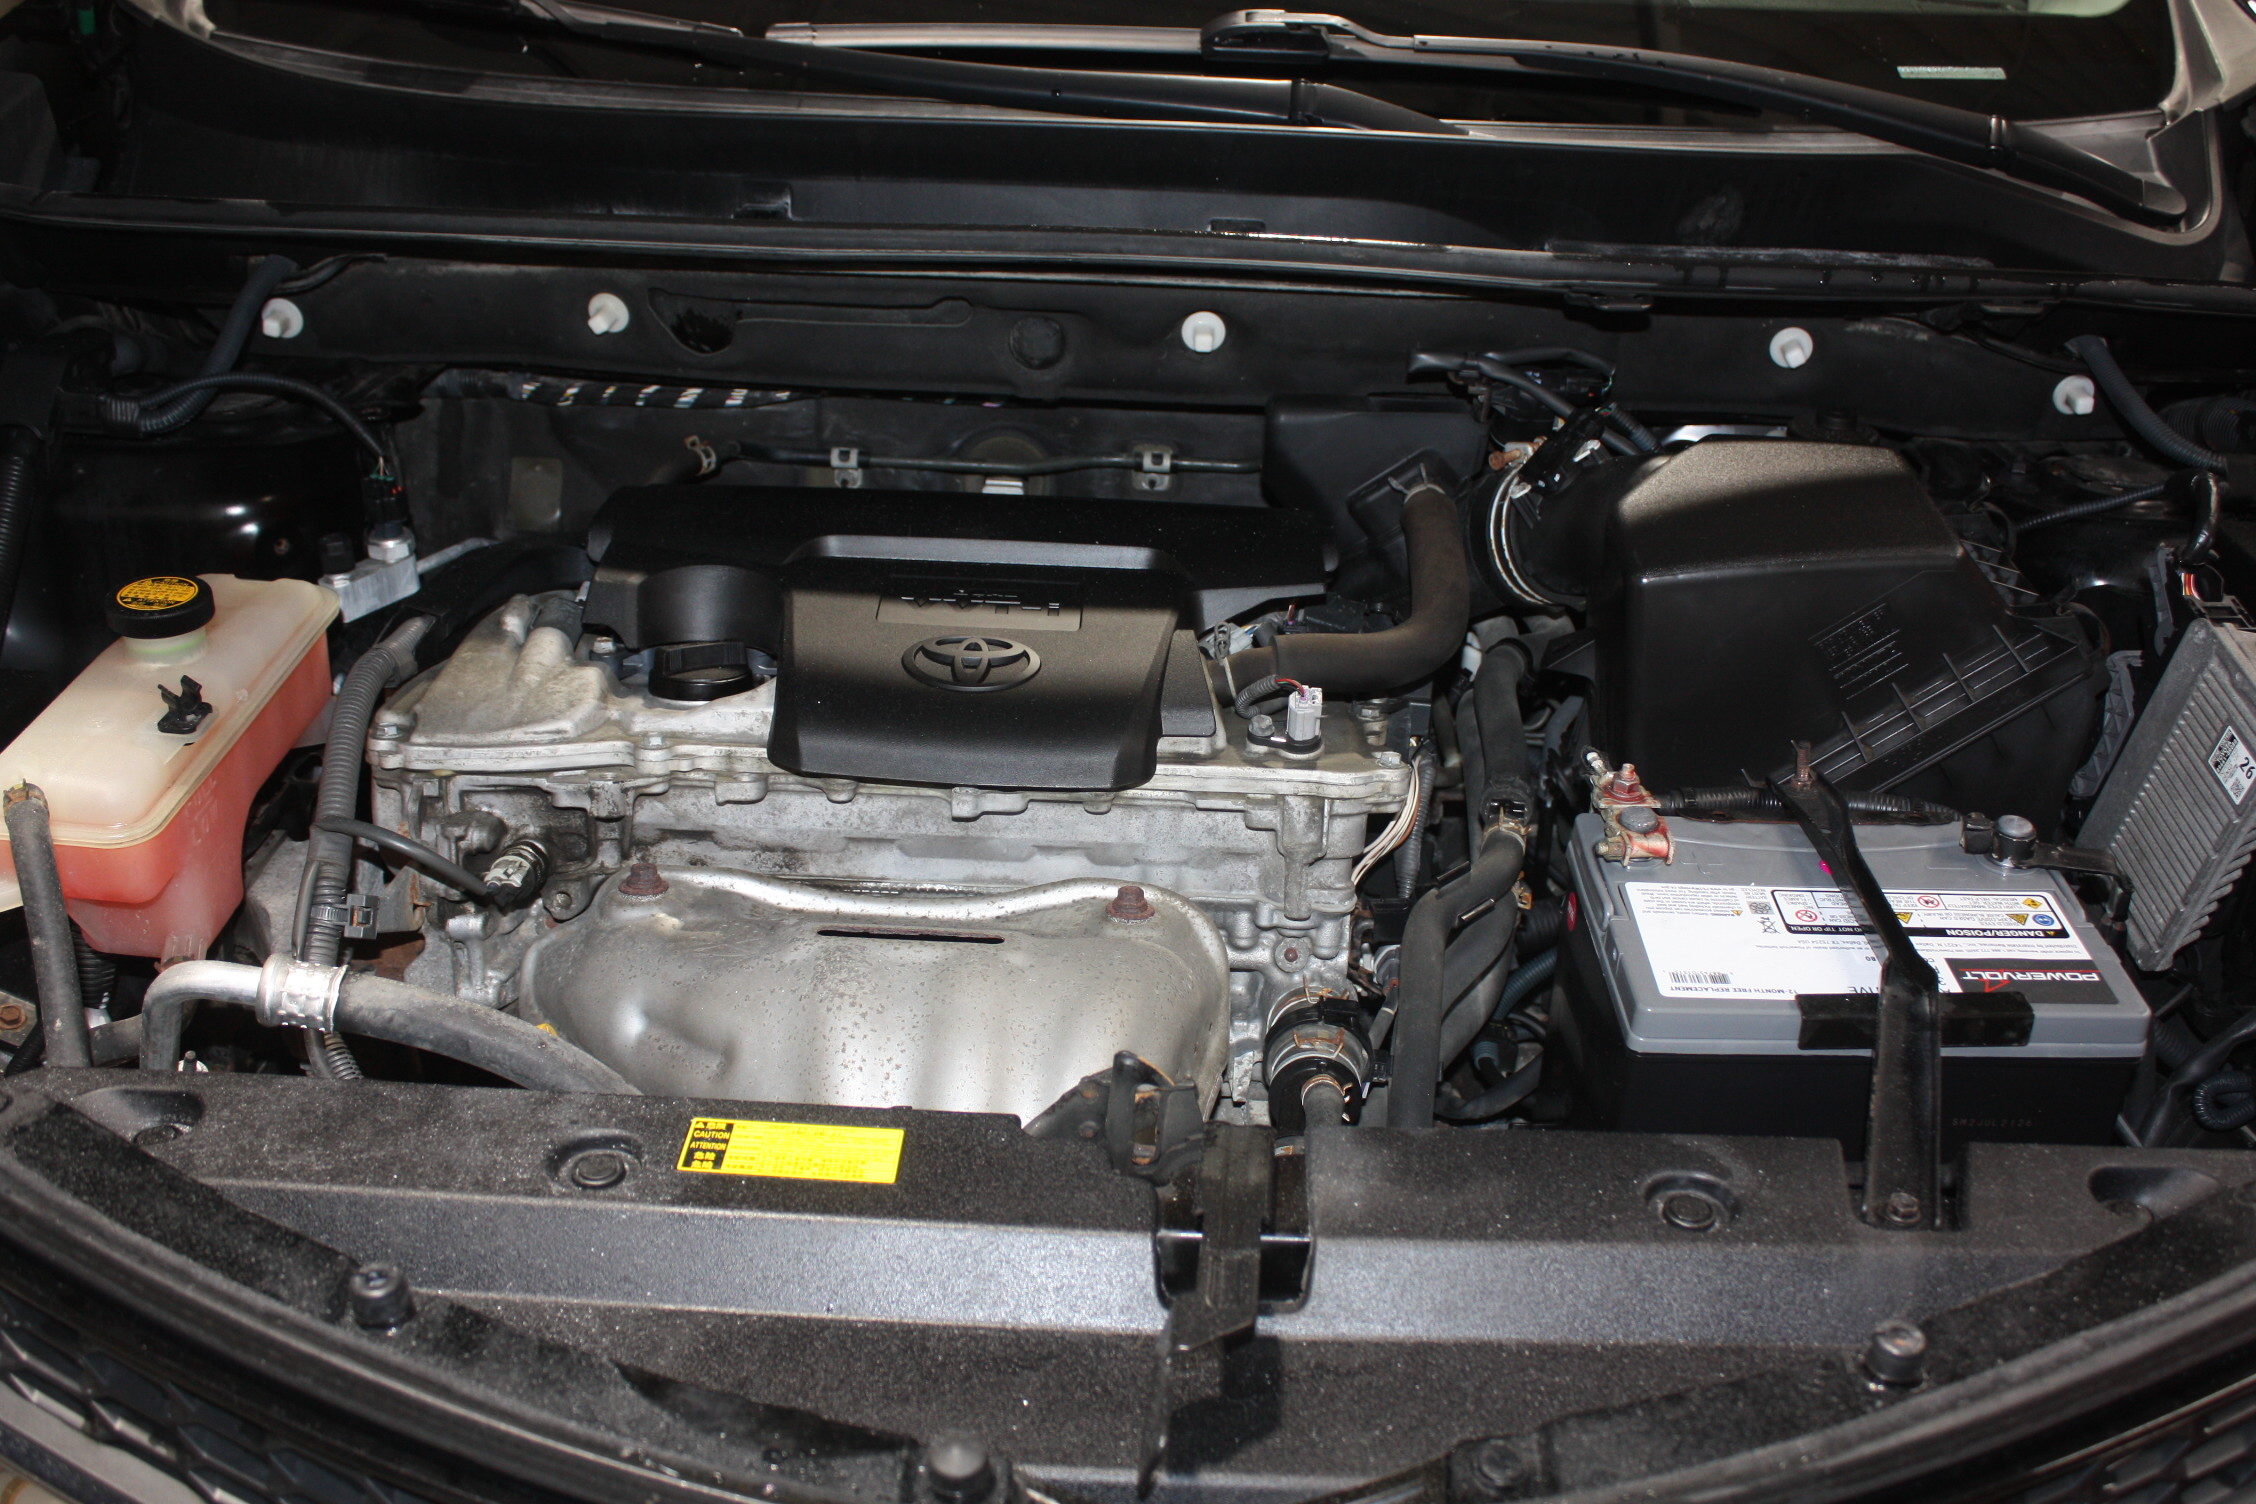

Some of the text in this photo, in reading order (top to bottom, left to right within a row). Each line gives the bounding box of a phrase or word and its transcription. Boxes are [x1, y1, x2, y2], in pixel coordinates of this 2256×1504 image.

[2239, 756, 2256, 780] 26
[1945, 929, 2044, 937] DANGER/POISON
[1962, 971, 2100, 981] POWERVOLT
[694, 1131, 730, 1139] CAUTION
[690, 1141, 727, 1151] ATTENTION
